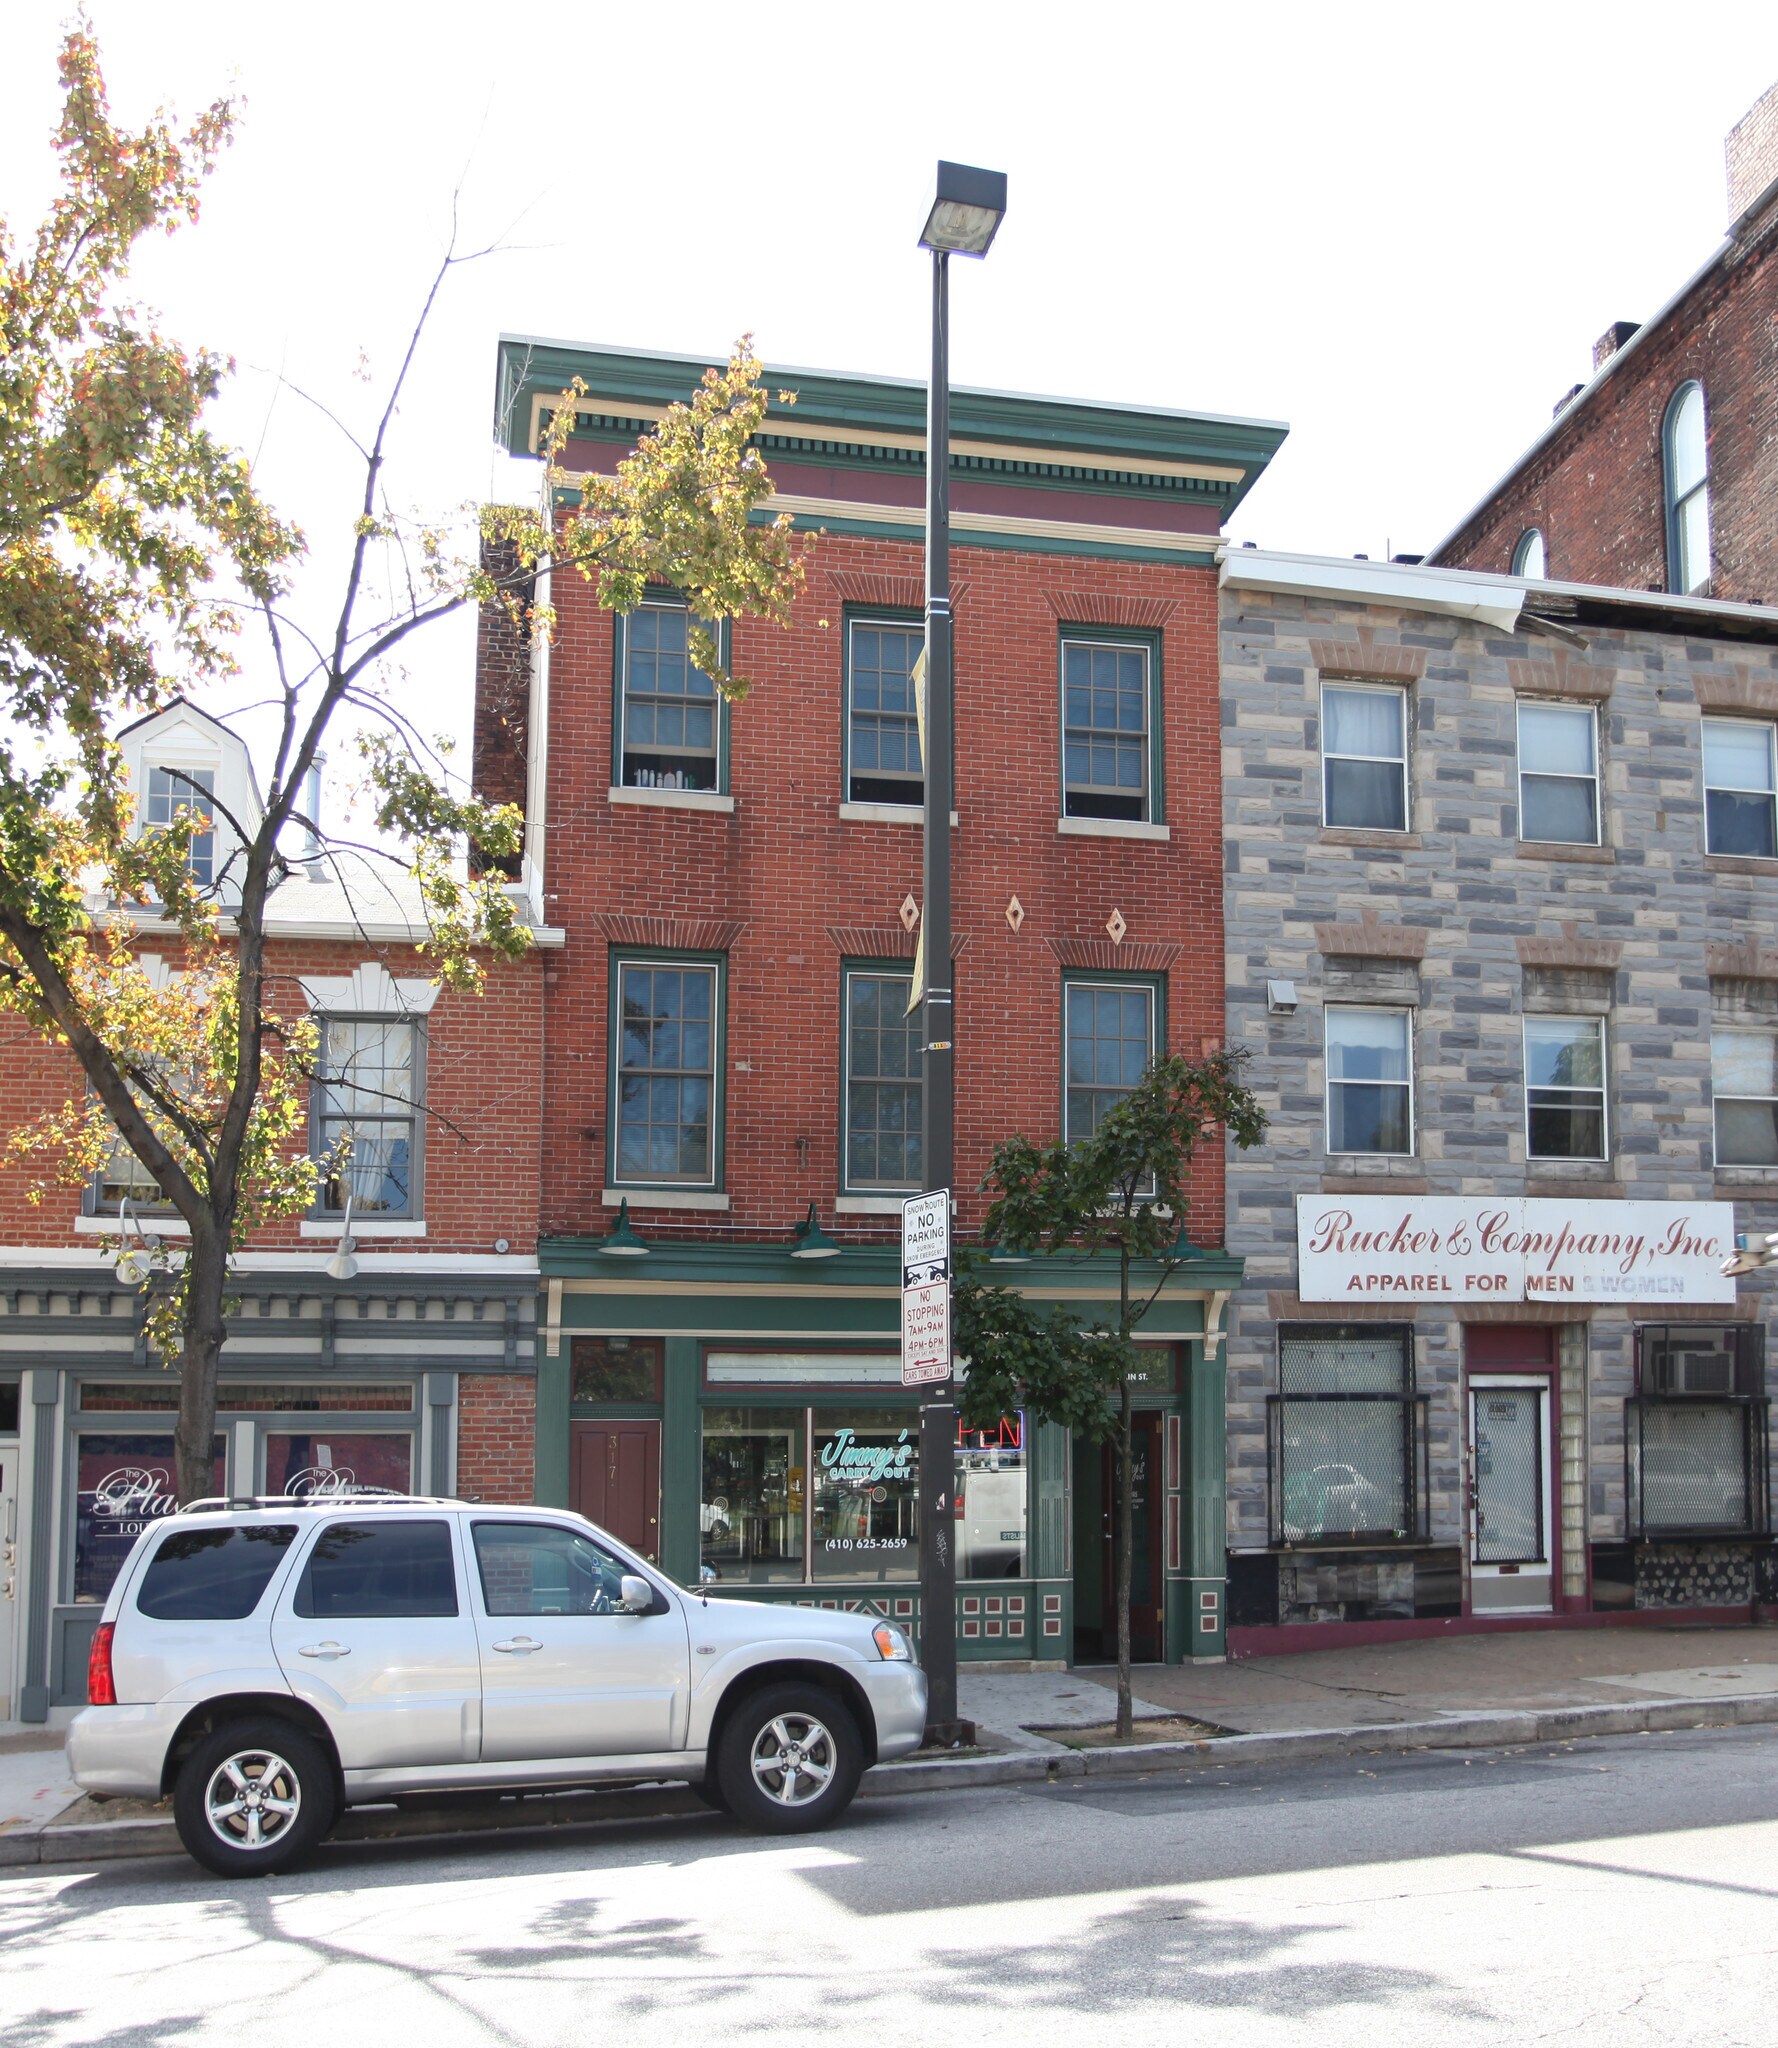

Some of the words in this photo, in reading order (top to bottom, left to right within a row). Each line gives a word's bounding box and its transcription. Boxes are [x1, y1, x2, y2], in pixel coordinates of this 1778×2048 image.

[907, 1203, 924, 1215] SNOW
[924, 1198, 944, 1211] ROUTE
[917, 1213, 934, 1229] NO
[907, 1226, 944, 1245] PARKING
[1309, 1210, 1442, 1254] Rucker
[1447, 1219, 1472, 1256] &
[1476, 1210, 1655, 1275] Company,
[1657, 1217, 1723, 1259] Inc.
[917, 1242, 935, 1252] DURING
[906, 1254, 919, 1263] SNOW
[919, 1248, 945, 1260] EMERGENCY
[1346, 1274, 1453, 1291] APPAREL
[1465, 1274, 1508, 1291] FOR
[1526, 1275, 1574, 1292] MEN
[1601, 1276, 1685, 1293] WOMEN
[920, 1290, 931, 1304] NO
[907, 1303, 944, 1322] STOPPING
[908, 1321, 943, 1337] 7AM-9AM
[908, 1337, 943, 1352] 4PM-6PM
[906, 1370, 917, 1381] CARS
[918, 1368, 933, 1379] TOWED
[934, 1366, 946, 1376] AWAY
[822, 1427, 911, 1481] Jimmy's
[125, 1469, 140, 1478] The
[312, 1469, 327, 1478] The
[829, 1466, 871, 1480] CARRY
[883, 1466, 911, 1479] OUT
[825, 1538, 853, 1552] (410)
[856, 1538, 907, 1549] 625-2659
